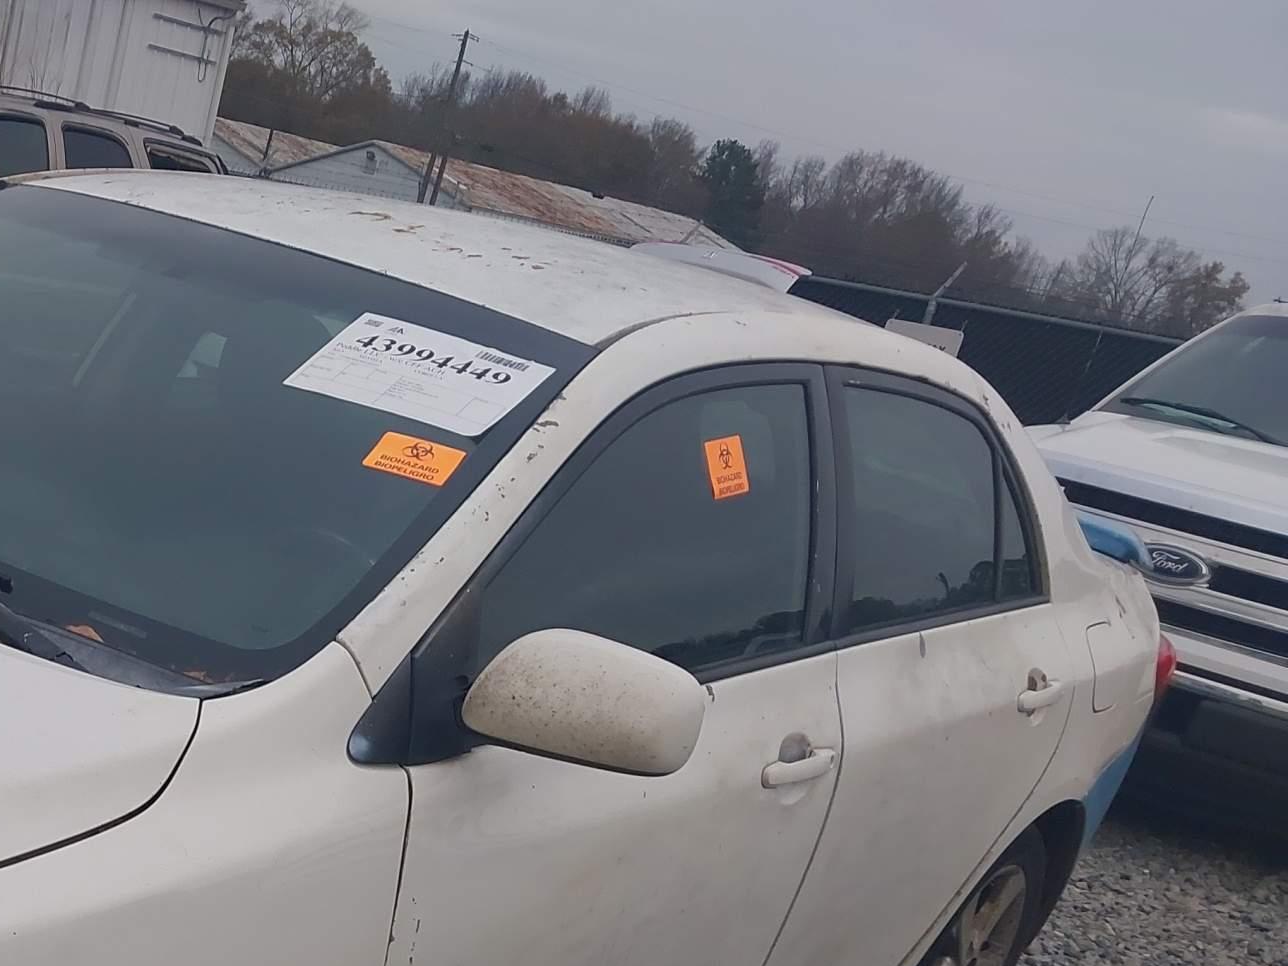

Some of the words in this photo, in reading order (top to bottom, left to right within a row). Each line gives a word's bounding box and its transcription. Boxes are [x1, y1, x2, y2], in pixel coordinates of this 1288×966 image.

[356, 335, 512, 386] 43994449
[374, 460, 434, 480] BIOPELIGRO
[380, 454, 439, 474] BIOHAZARD
[1152, 551, 1189, 573] Ford
